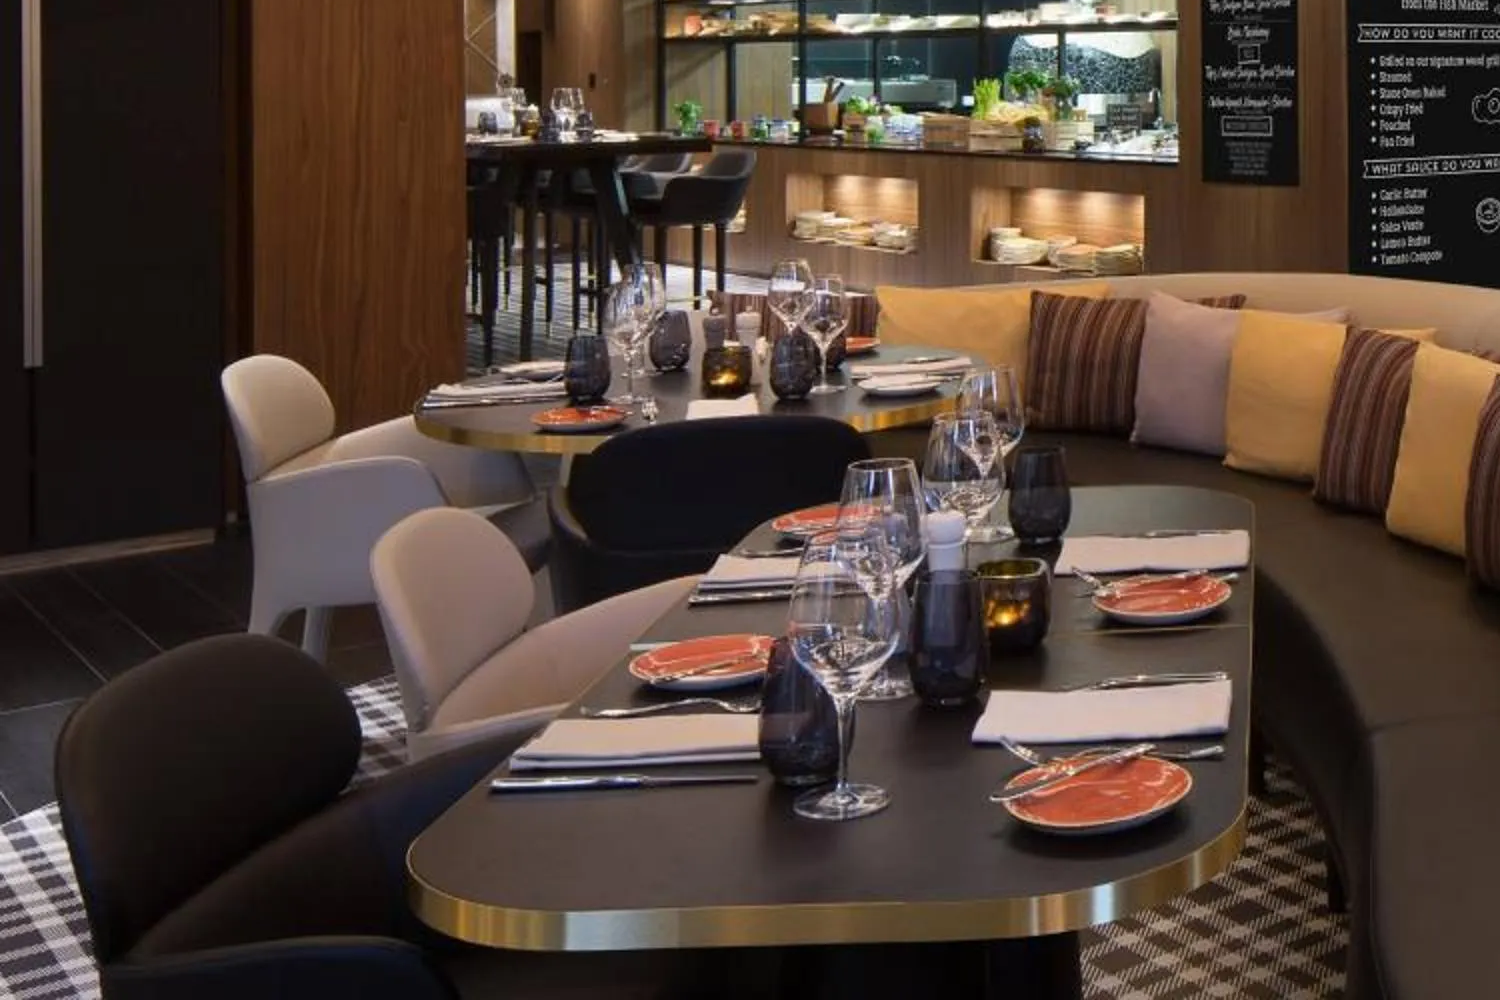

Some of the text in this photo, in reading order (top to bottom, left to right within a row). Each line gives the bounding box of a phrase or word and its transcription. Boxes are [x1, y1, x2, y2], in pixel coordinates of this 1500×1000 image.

[1365, 28, 1391, 39] HOW
[1393, 28, 1409, 39] DO
[1413, 28, 1435, 39] YOU
[1437, 29, 1466, 39] WANT
[1469, 29, 1479, 39] IT
[1372, 163, 1402, 174] WHAT
[1406, 161, 1439, 173] SAUCE
[1442, 160, 1457, 171] DO
[1460, 159, 1481, 170] YOU
